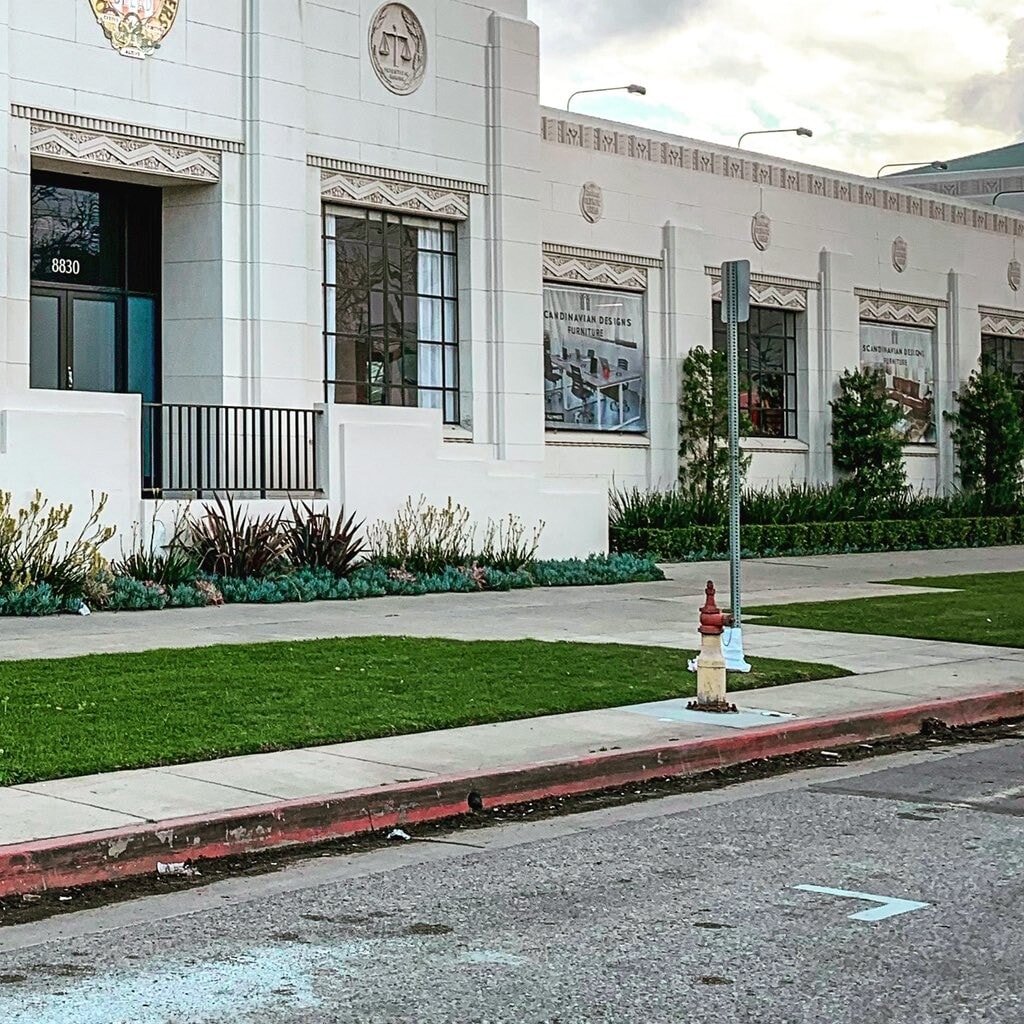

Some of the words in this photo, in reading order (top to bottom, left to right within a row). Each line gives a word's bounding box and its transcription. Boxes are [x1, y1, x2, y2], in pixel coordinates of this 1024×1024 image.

[52, 258, 80, 275] 8830
[543, 310, 596, 324] CANDINAVIAN
[599, 316, 632, 327] DESIGNS
[567, 326, 604, 337] FURNITURE
